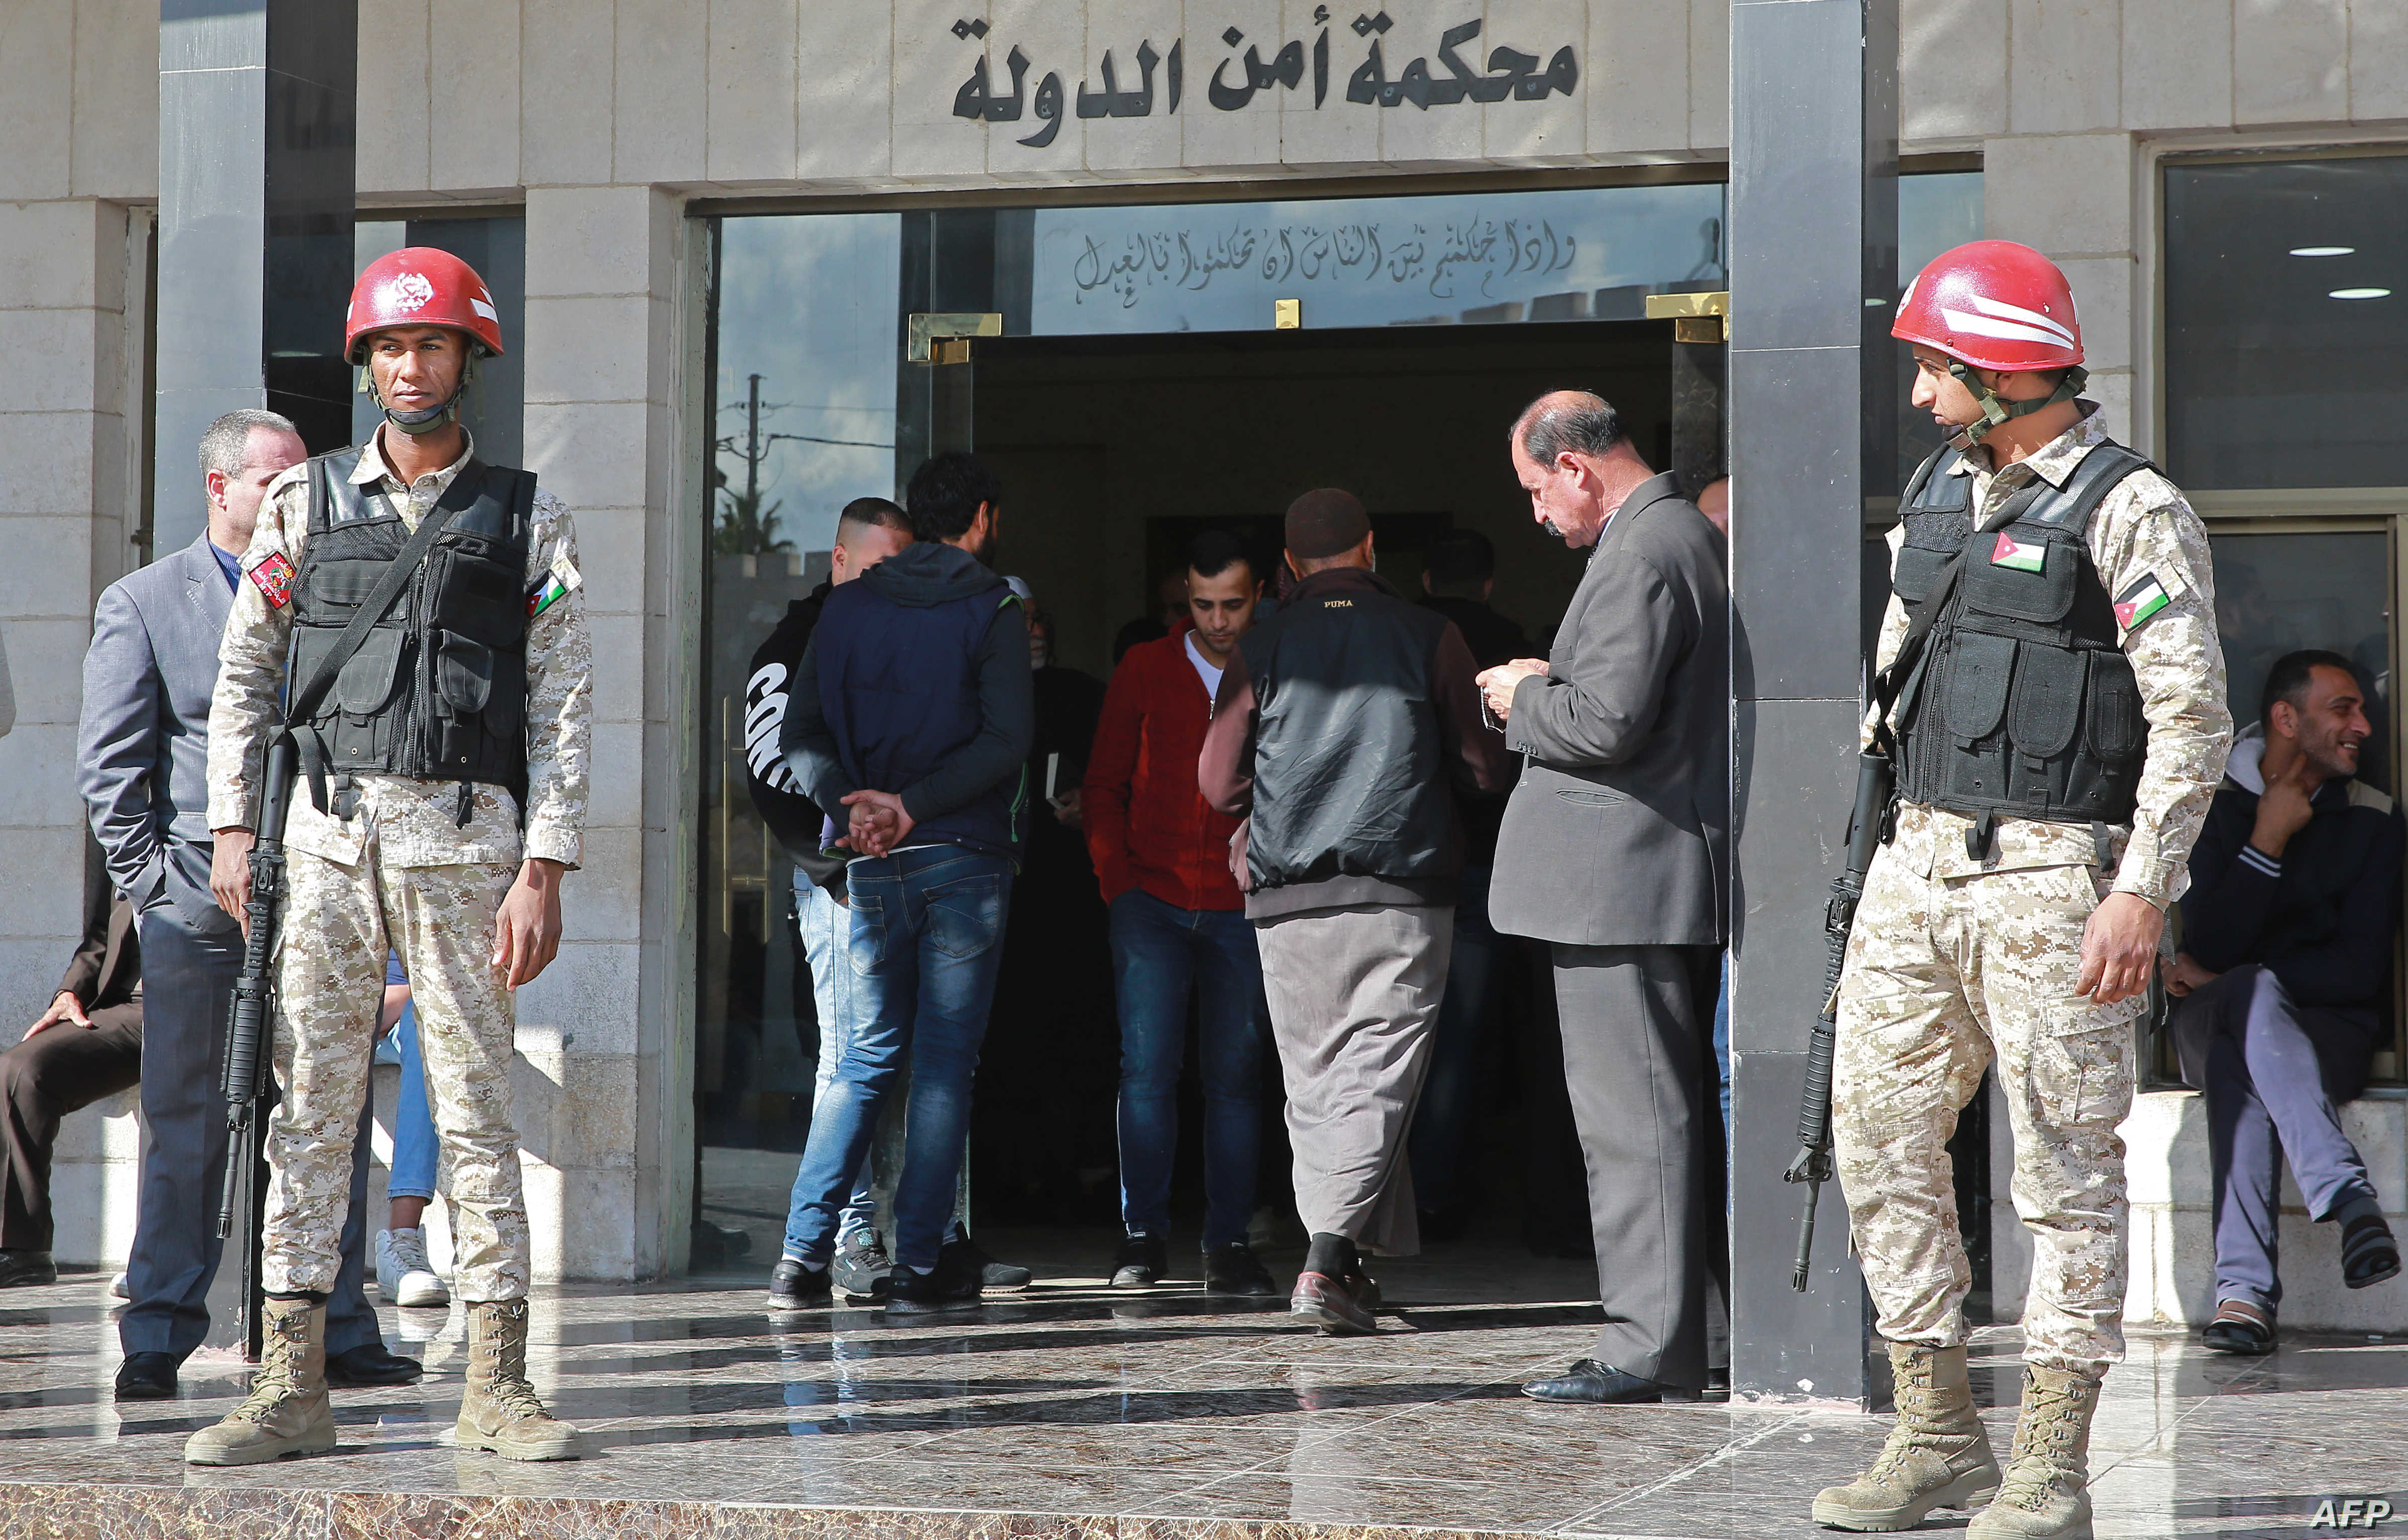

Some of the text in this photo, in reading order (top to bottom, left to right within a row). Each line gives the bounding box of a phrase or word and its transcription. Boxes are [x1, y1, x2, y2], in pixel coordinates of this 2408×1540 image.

[951, 4, 1578, 148] محكمة أمن الدولة
[1074, 232, 1170, 308] بالعدل
[1176, 220, 1255, 290] تحكموا
[1300, 224, 1381, 281] الناس
[1387, 224, 1425, 282] بين
[1430, 209, 1497, 299] حكمتم
[1324, 600, 1353, 608] PUMA
